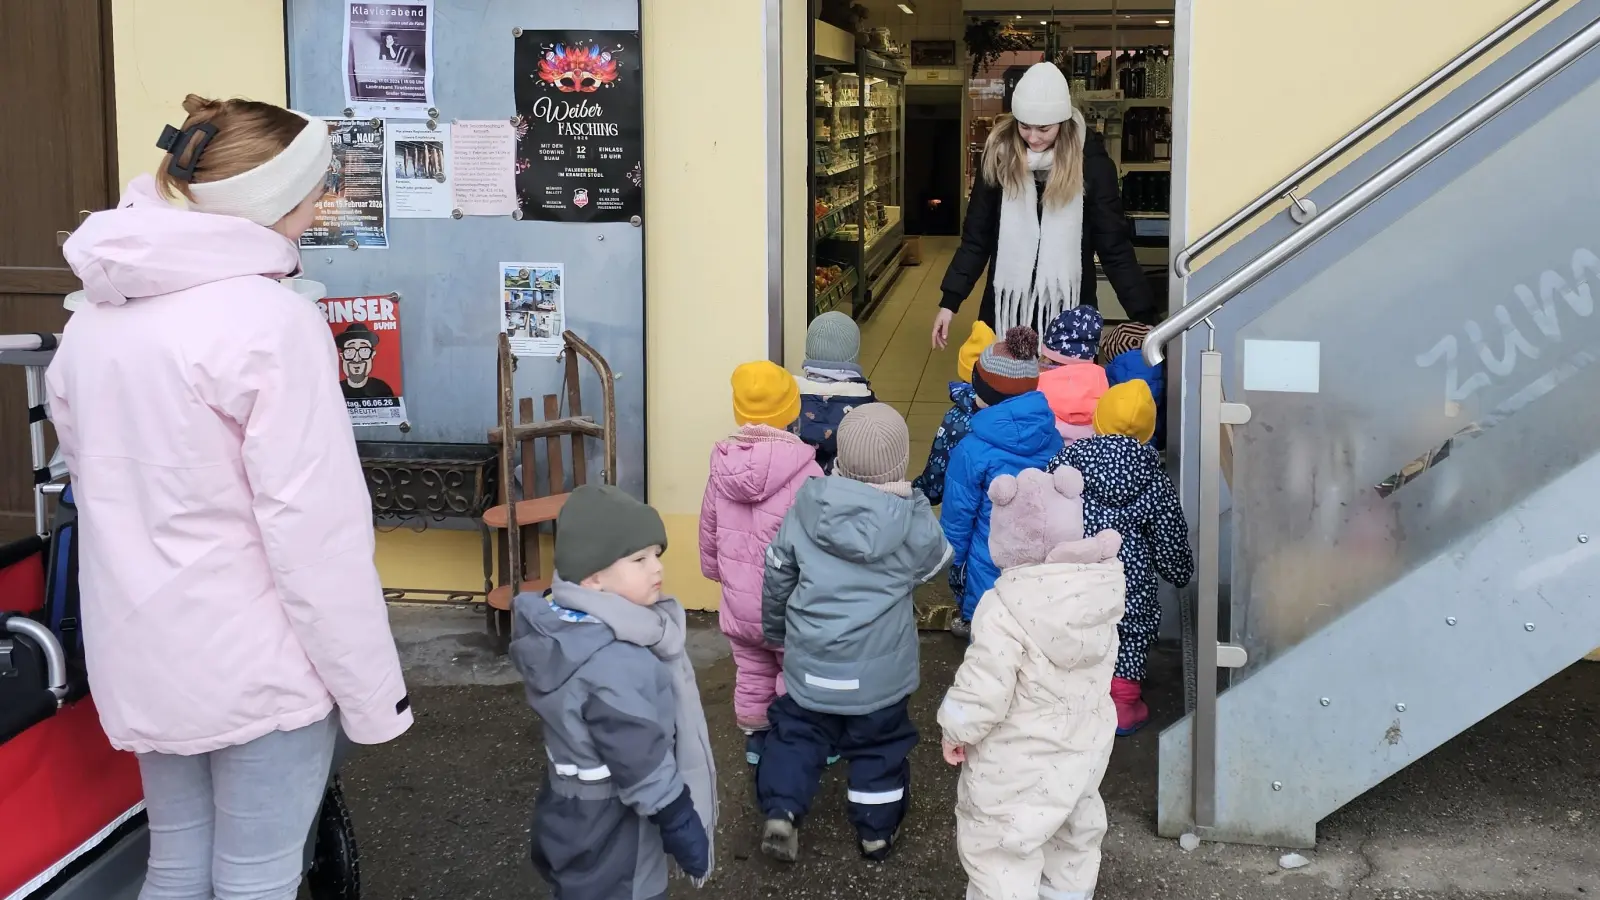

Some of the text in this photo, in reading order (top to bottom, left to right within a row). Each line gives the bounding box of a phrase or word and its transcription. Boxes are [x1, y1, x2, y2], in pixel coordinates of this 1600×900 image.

[352, 6, 424, 17] Klavierabend
[533, 96, 603, 123] Weiber
[558, 122, 619, 136] FASCHING
[576, 146, 586, 154] 12
[323, 200, 335, 208] den
[373, 321, 397, 331] BUMM
[346, 398, 394, 408] tag, 06.06.26
